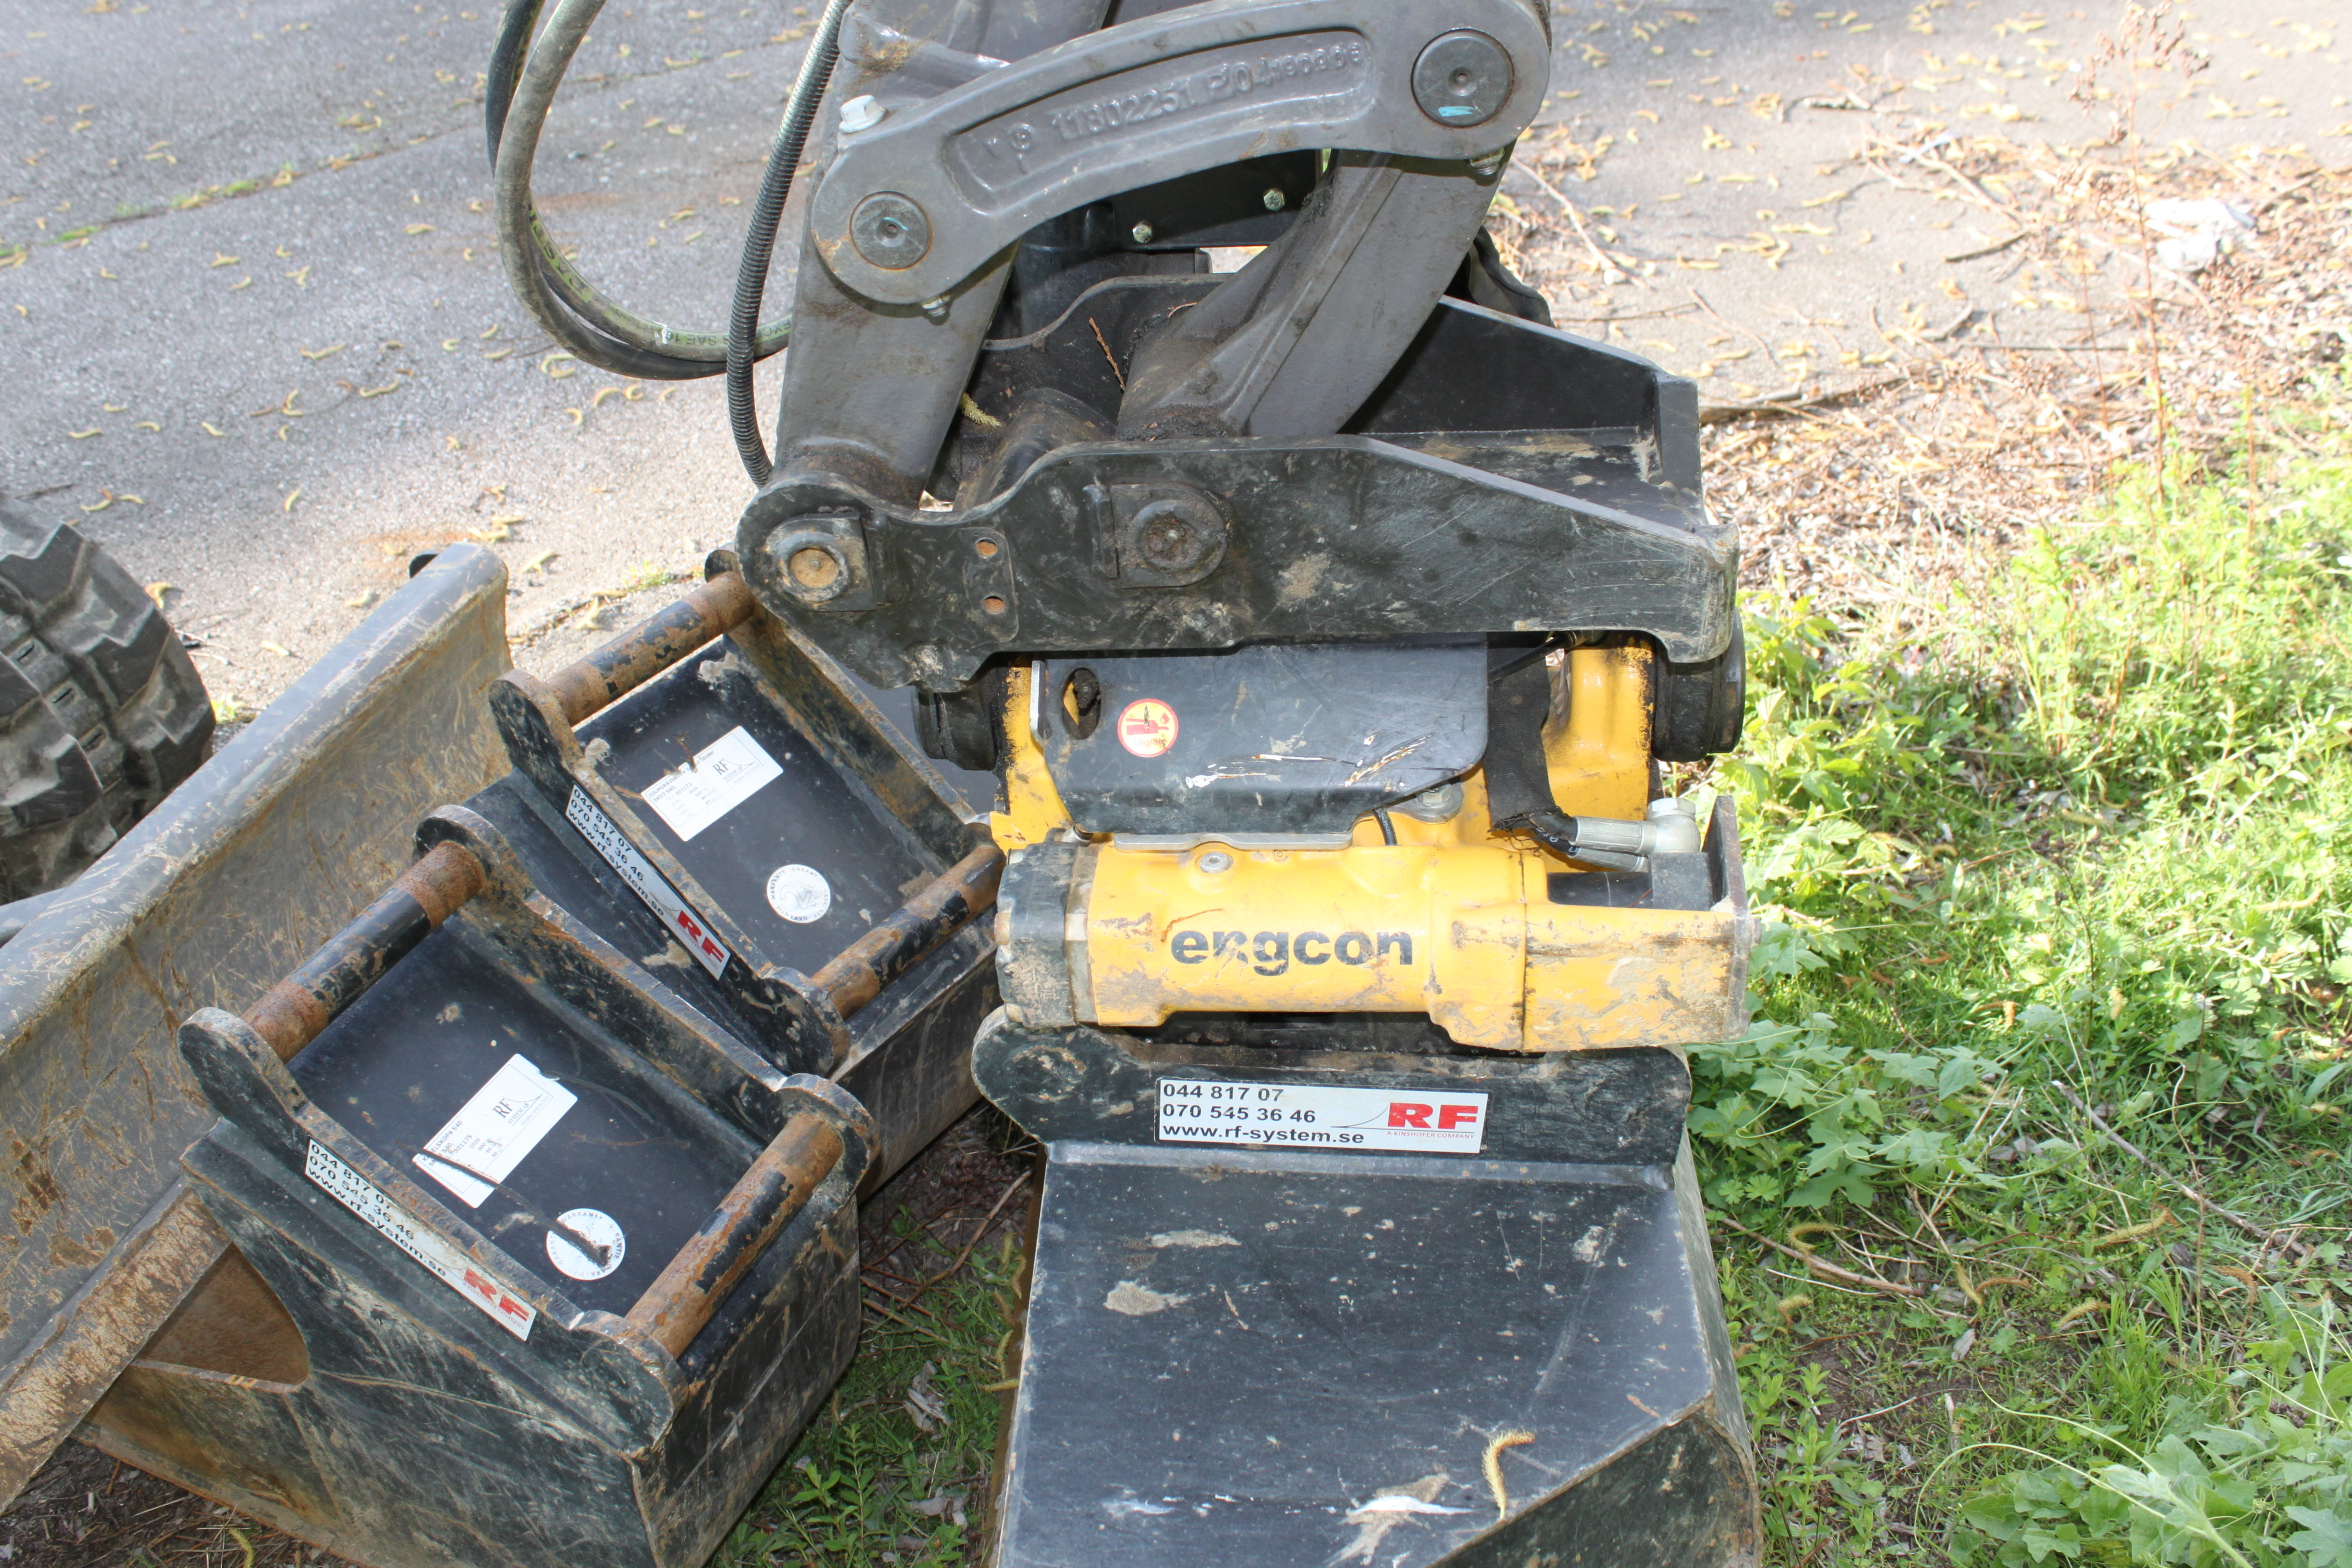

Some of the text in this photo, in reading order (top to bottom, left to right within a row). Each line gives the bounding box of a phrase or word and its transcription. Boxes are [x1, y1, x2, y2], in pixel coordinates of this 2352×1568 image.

[711, 758, 731, 776] RF
[569, 797, 644, 883] 070 545 36 46
[572, 787, 632, 856] 044 817 07
[566, 808, 665, 918] www.rf-system.se
[676, 908, 725, 967] RF
[1171, 930, 1412, 976] engcon
[491, 1096, 516, 1119] RF
[1163, 1083, 1284, 1102] 044 817 07
[1163, 1103, 1316, 1123] 070 545 36 46
[1388, 1102, 1479, 1130] RF
[1163, 1125, 1365, 1144] www.rf-system.se
[310, 1142, 339, 1171] 044
[342, 1166, 370, 1194] 817
[307, 1165, 447, 1280] www.rf-system.se
[308, 1153, 415, 1242] 070 545 36 46
[462, 1265, 530, 1327] RF
